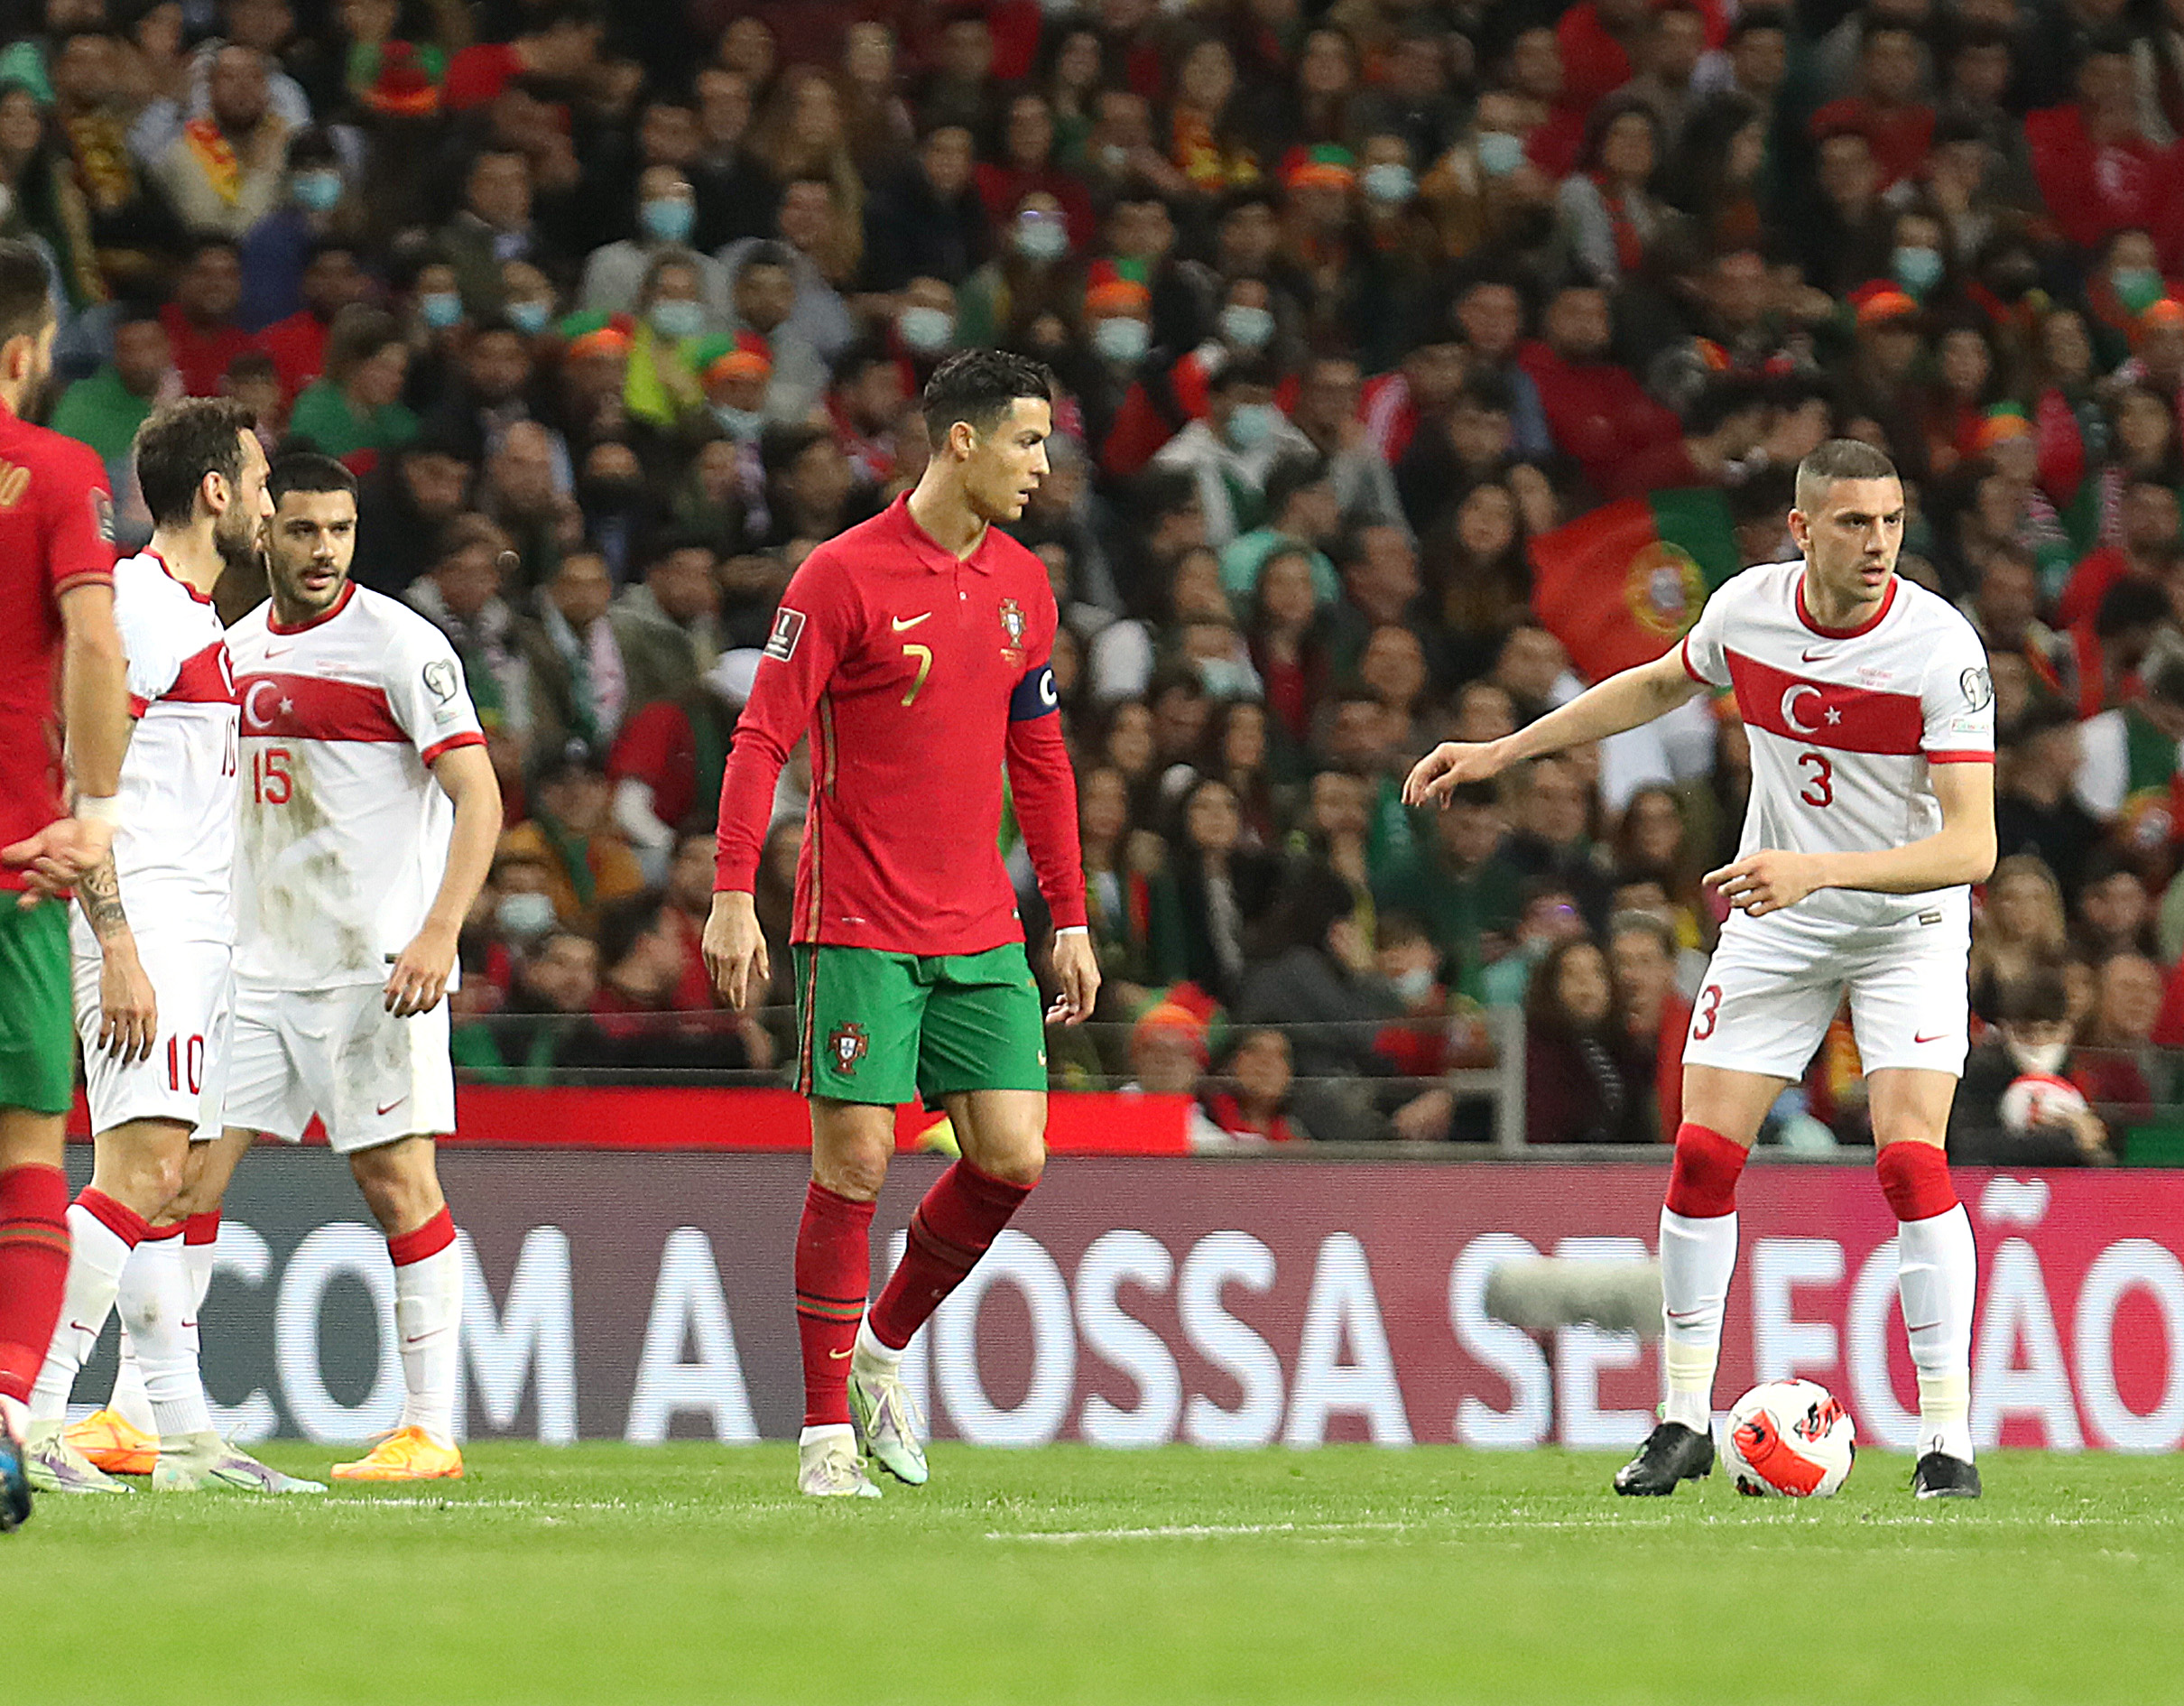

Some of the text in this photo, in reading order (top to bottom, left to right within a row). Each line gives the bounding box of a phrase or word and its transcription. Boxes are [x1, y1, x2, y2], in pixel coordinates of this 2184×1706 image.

[901, 644, 933, 707] 7
[254, 748, 293, 805] 15
[1799, 752, 1833, 807] 3
[1693, 985, 1723, 1040] 3
[167, 1032, 204, 1096] 10
[623, 1224, 763, 1446] A
[1448, 1175, 2184, 1453] SEEÃO
